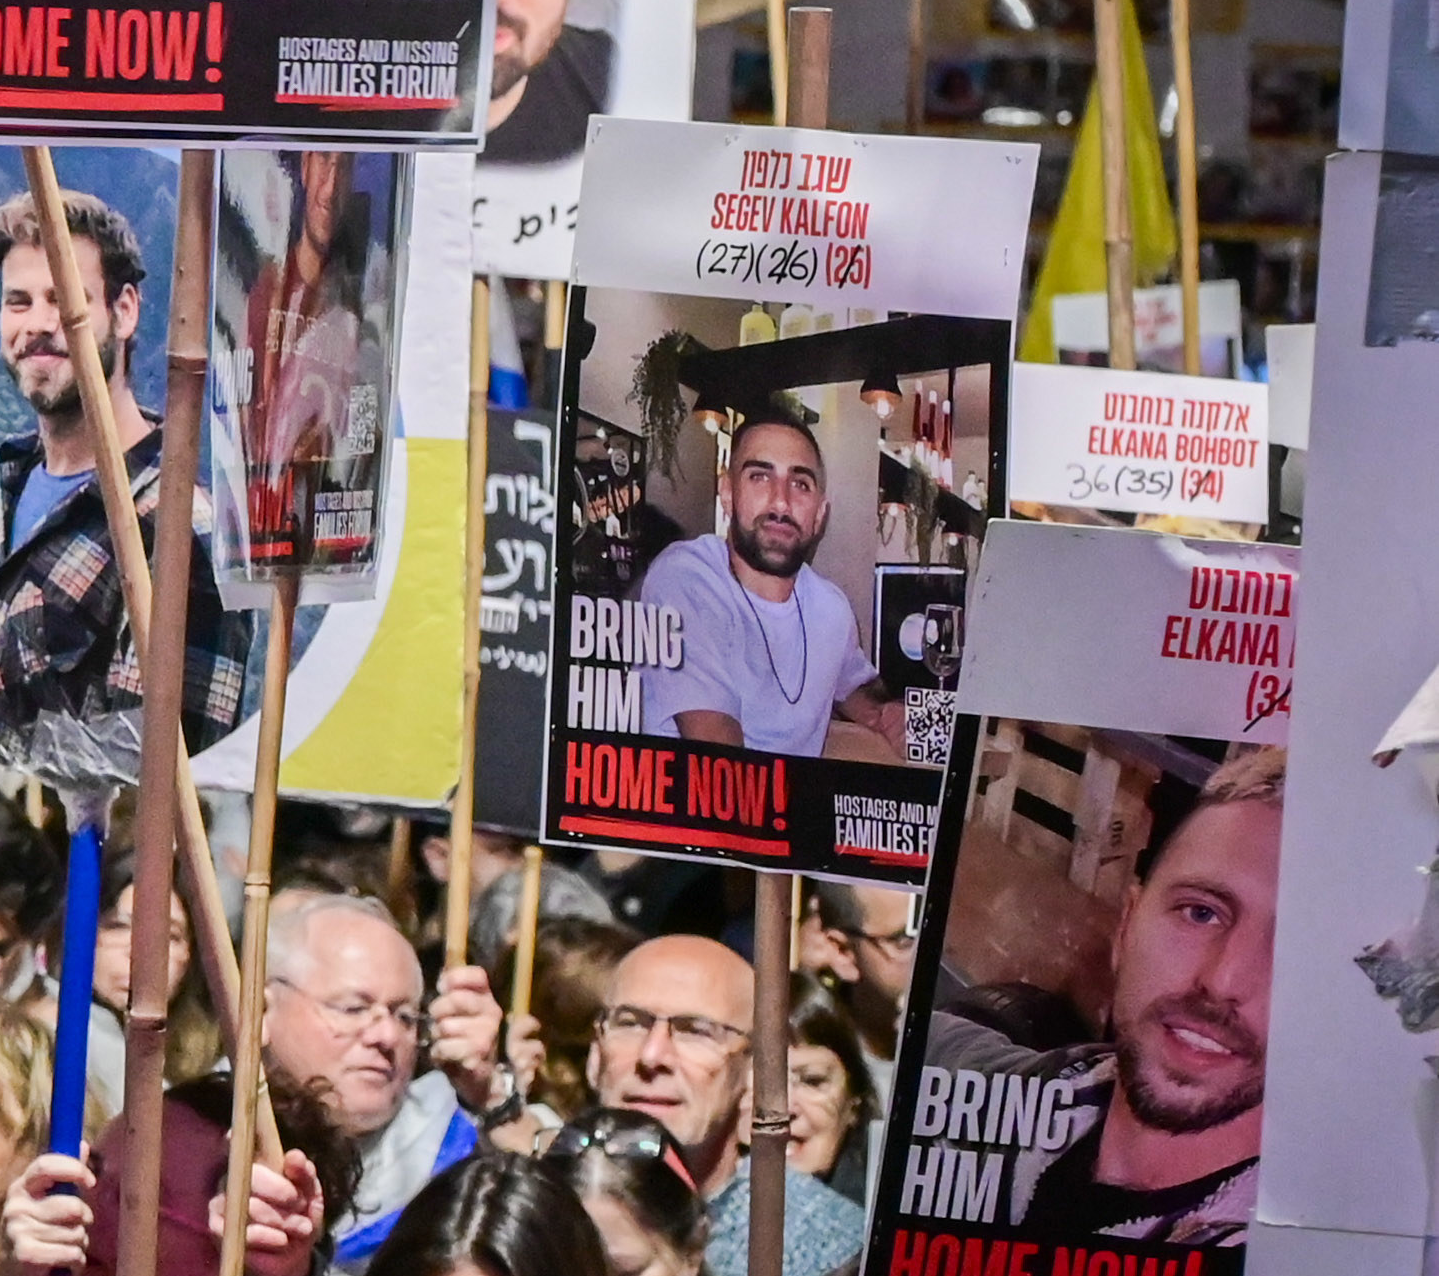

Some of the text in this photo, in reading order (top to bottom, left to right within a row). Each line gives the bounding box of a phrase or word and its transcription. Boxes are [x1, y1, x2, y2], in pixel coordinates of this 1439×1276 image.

[85, 1, 223, 84] NOW!
[279, 38, 459, 64] HOSTAGES AND MISSING
[278, 62, 456, 101] FAMILIES FORUM
[738, 150, 852, 193] שגב כלפון
[711, 192, 870, 240] SEGEV KALFON
[1103, 395, 1252, 433] אלקנה בוחבוט
[1088, 426, 1258, 469] ELKANA BOHBOT
[1189, 566, 1292, 617] בוחבוט
[569, 594, 684, 667] BRING
[1160, 614, 1281, 667] ELKANA
[567, 664, 641, 734] HIM
[565, 742, 791, 831] HOME NOW!
[836, 815, 915, 853] FAMILIES
[920, 1066, 1076, 1150] BRING
[899, 1146, 1004, 1224] HIM
